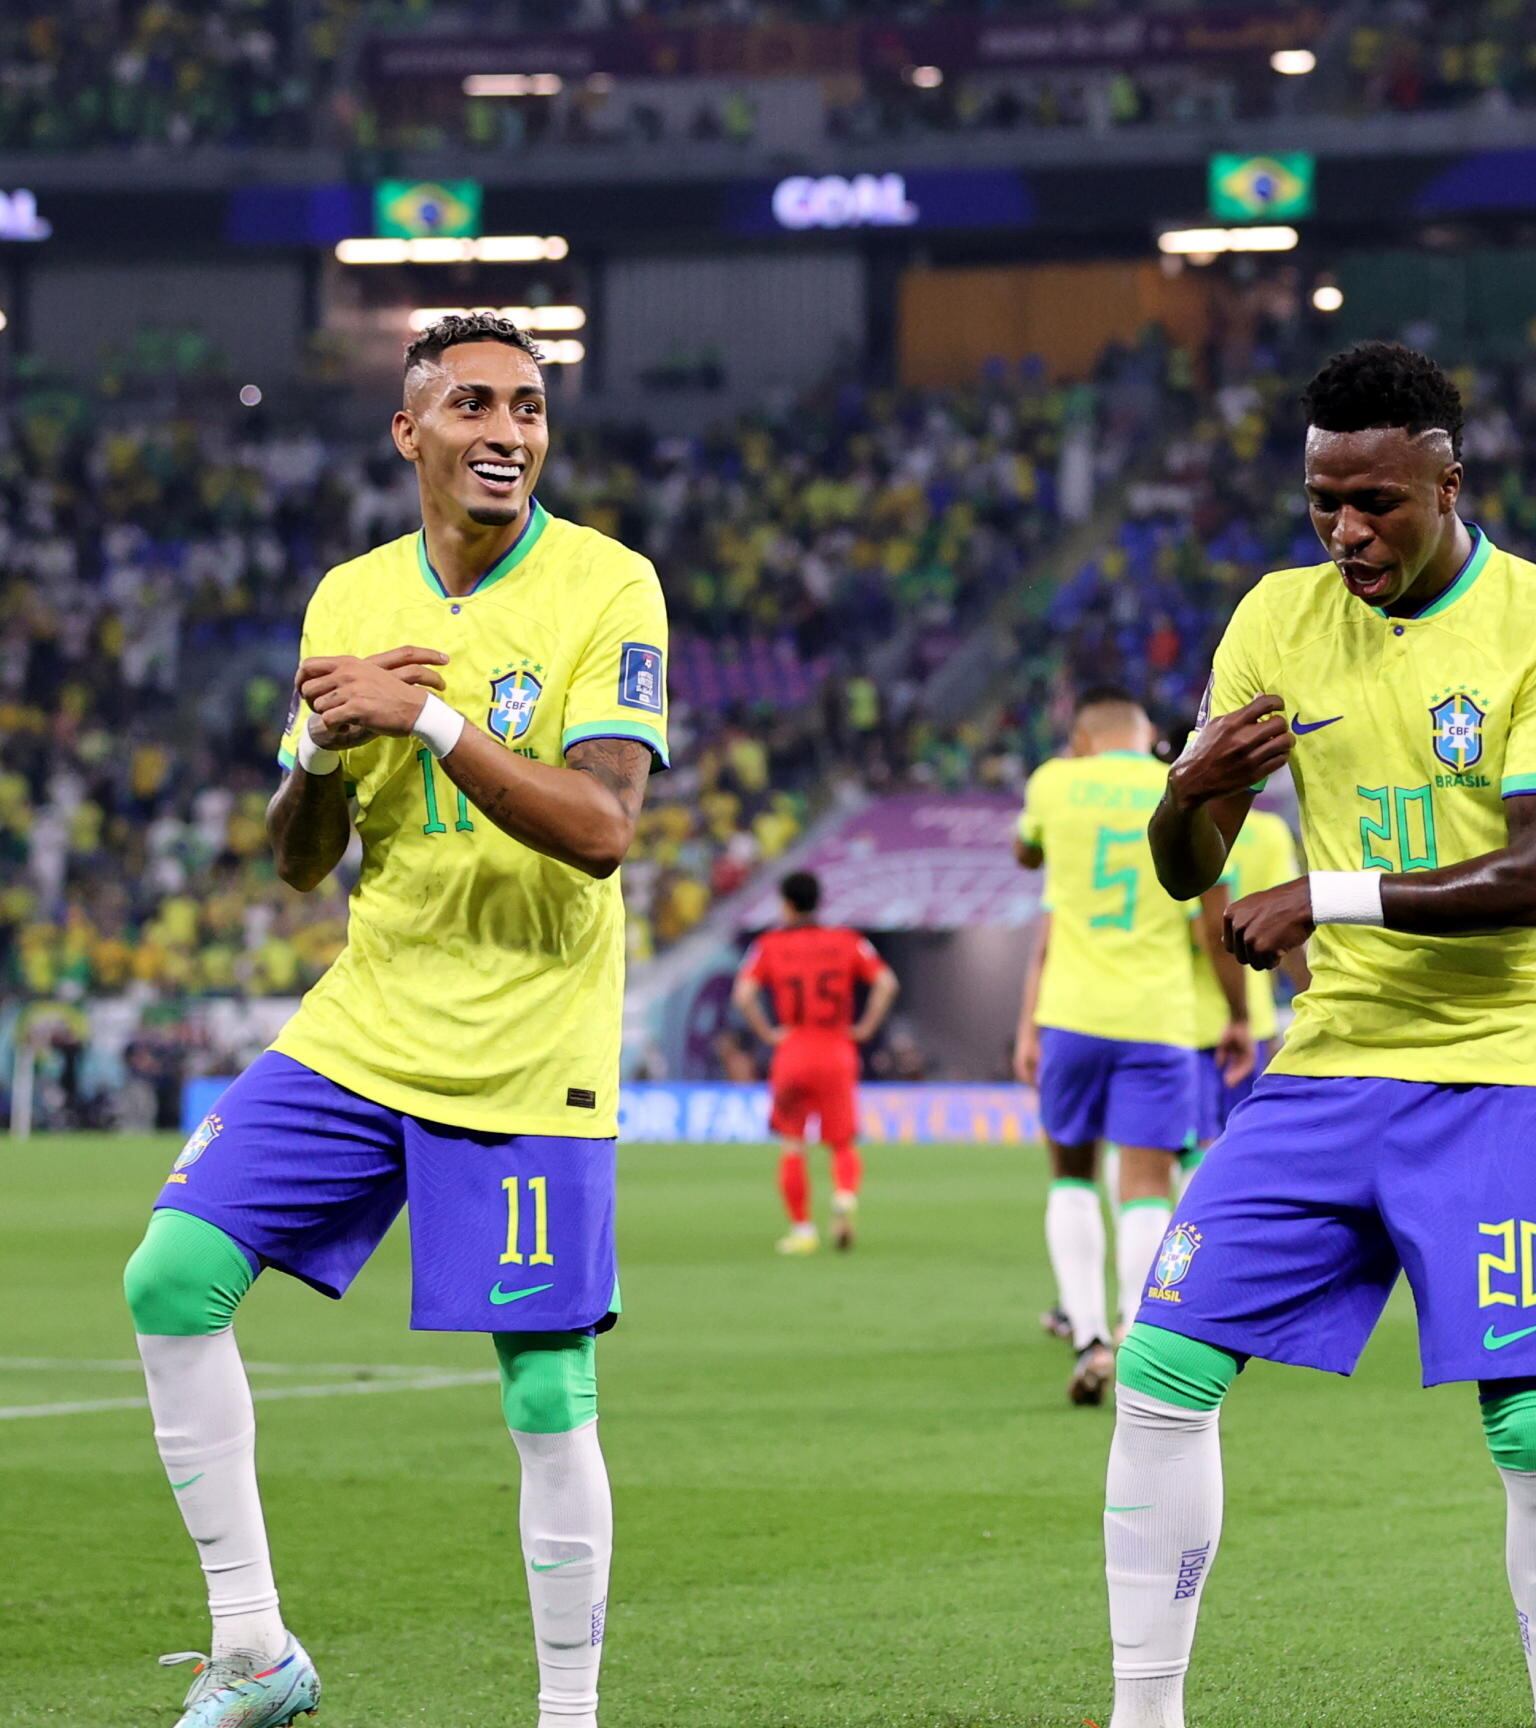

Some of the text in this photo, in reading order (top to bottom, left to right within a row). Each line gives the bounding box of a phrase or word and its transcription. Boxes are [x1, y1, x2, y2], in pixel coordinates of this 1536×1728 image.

[772, 172, 920, 230] GOAL
[505, 699, 526, 711] CBF
[1448, 726, 1470, 736] CBF
[1435, 773, 1491, 789] BRASIL
[1357, 784, 1438, 873] 20
[1090, 825, 1144, 932] 5
[784, 968, 845, 1027] 15
[619, 1089, 680, 1143] OR
[499, 1176, 554, 1266] 11
[1148, 1286, 1181, 1303] BRASIL
[1174, 1540, 1210, 1600] BRASIL
